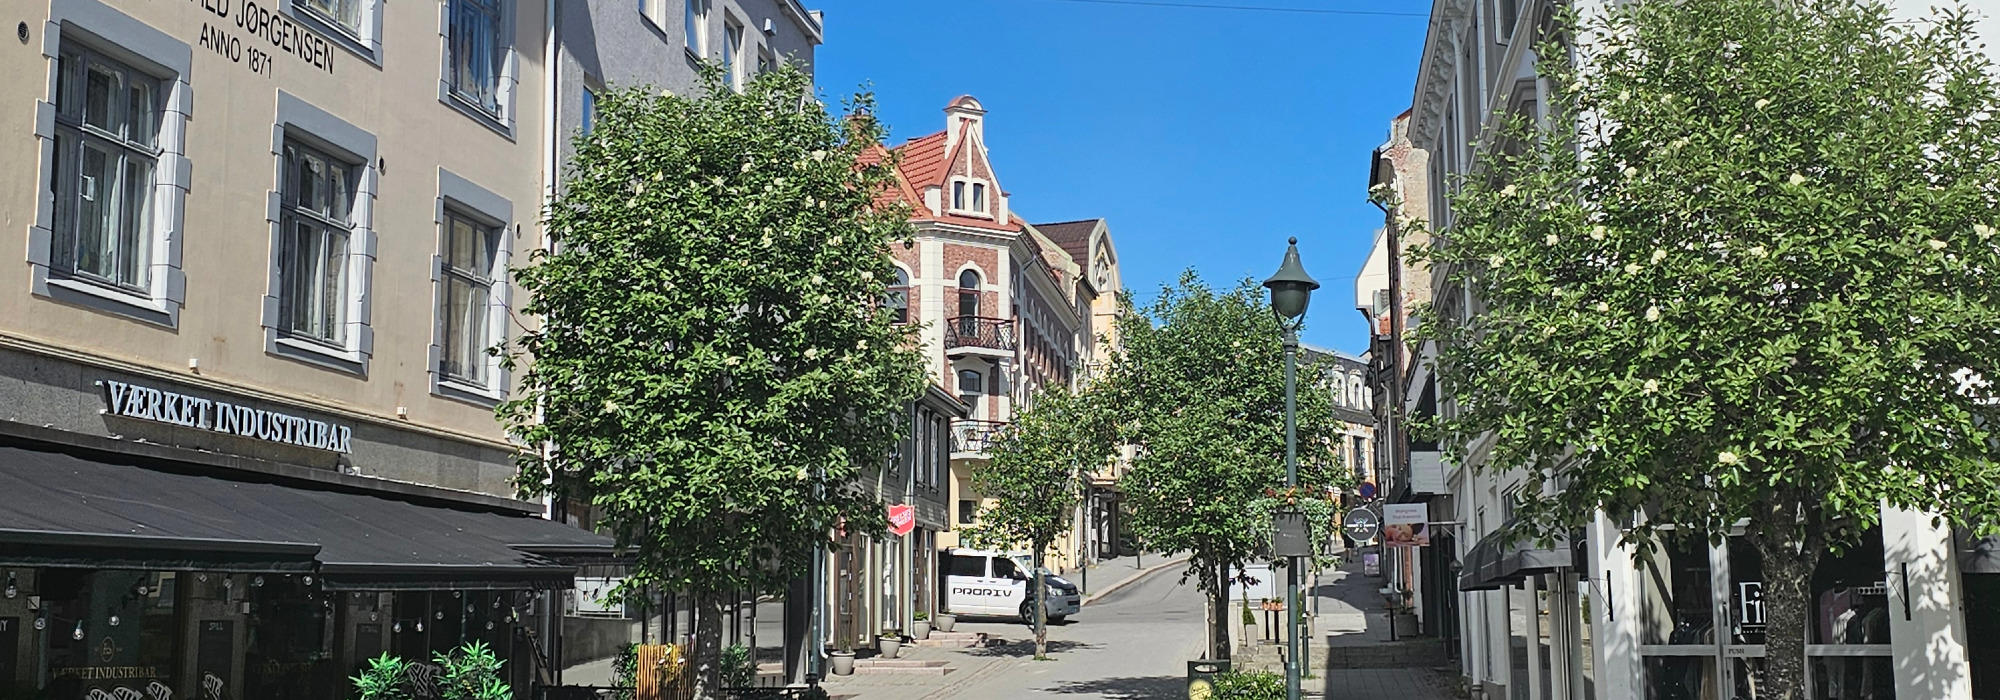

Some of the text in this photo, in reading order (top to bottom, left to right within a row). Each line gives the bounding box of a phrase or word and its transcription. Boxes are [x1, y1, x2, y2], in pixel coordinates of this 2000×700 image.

[199, 22, 273, 79] ANNO 1871
[235, 0, 334, 75] JØRGENSEN
[108, 380, 353, 454] VÆRKET INDUSTRIBAR
[95, 666, 157, 680] INDUSTRIBAR
